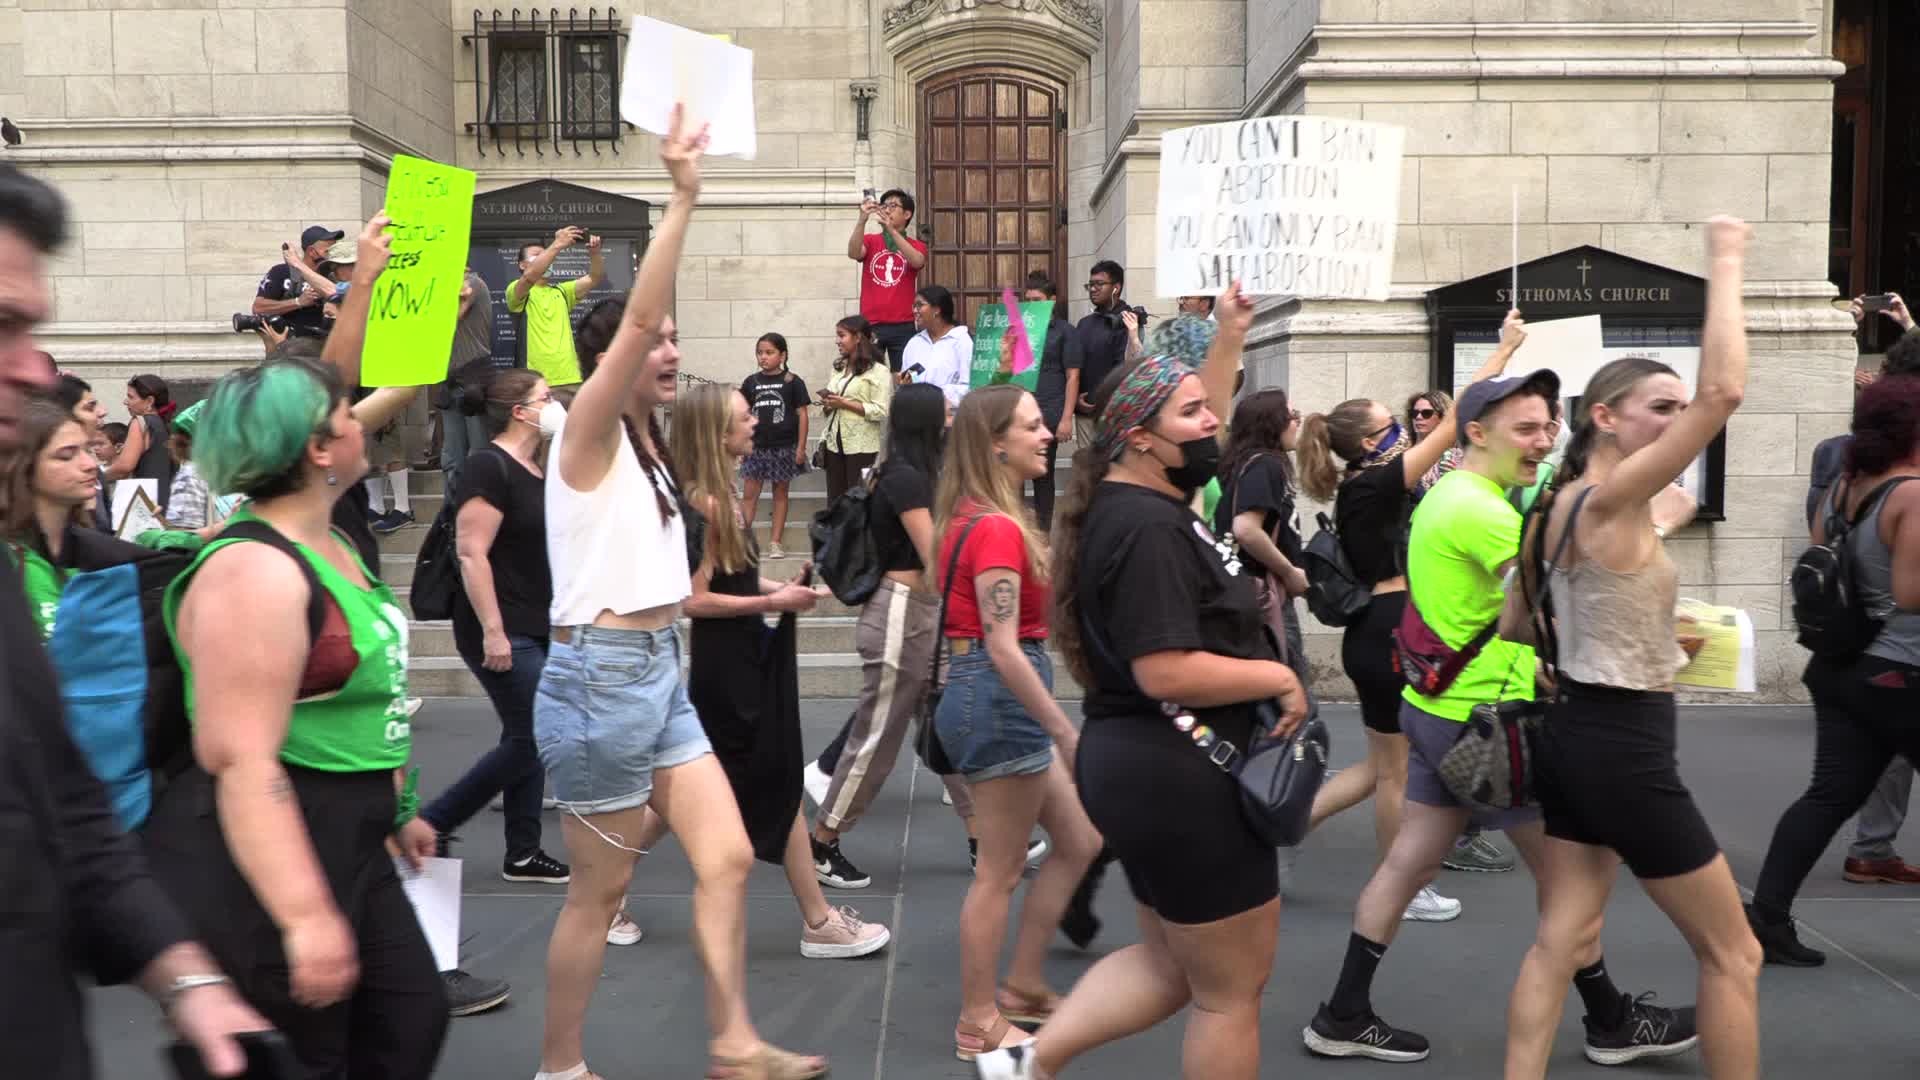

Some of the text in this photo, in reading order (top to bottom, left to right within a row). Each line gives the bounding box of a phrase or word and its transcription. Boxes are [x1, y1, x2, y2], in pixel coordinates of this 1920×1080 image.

[1180, 127, 1224, 165] YOU
[1320, 120, 1378, 163] BAN
[1216, 163, 1341, 205] ABORTION
[559, 203, 613, 214] CHURCH
[1335, 214, 1388, 252] BAN
[1249, 251, 1372, 298] ABORTION
[1600, 287, 1670, 302] CHURCH
[368, 277, 437, 321] NOW!
